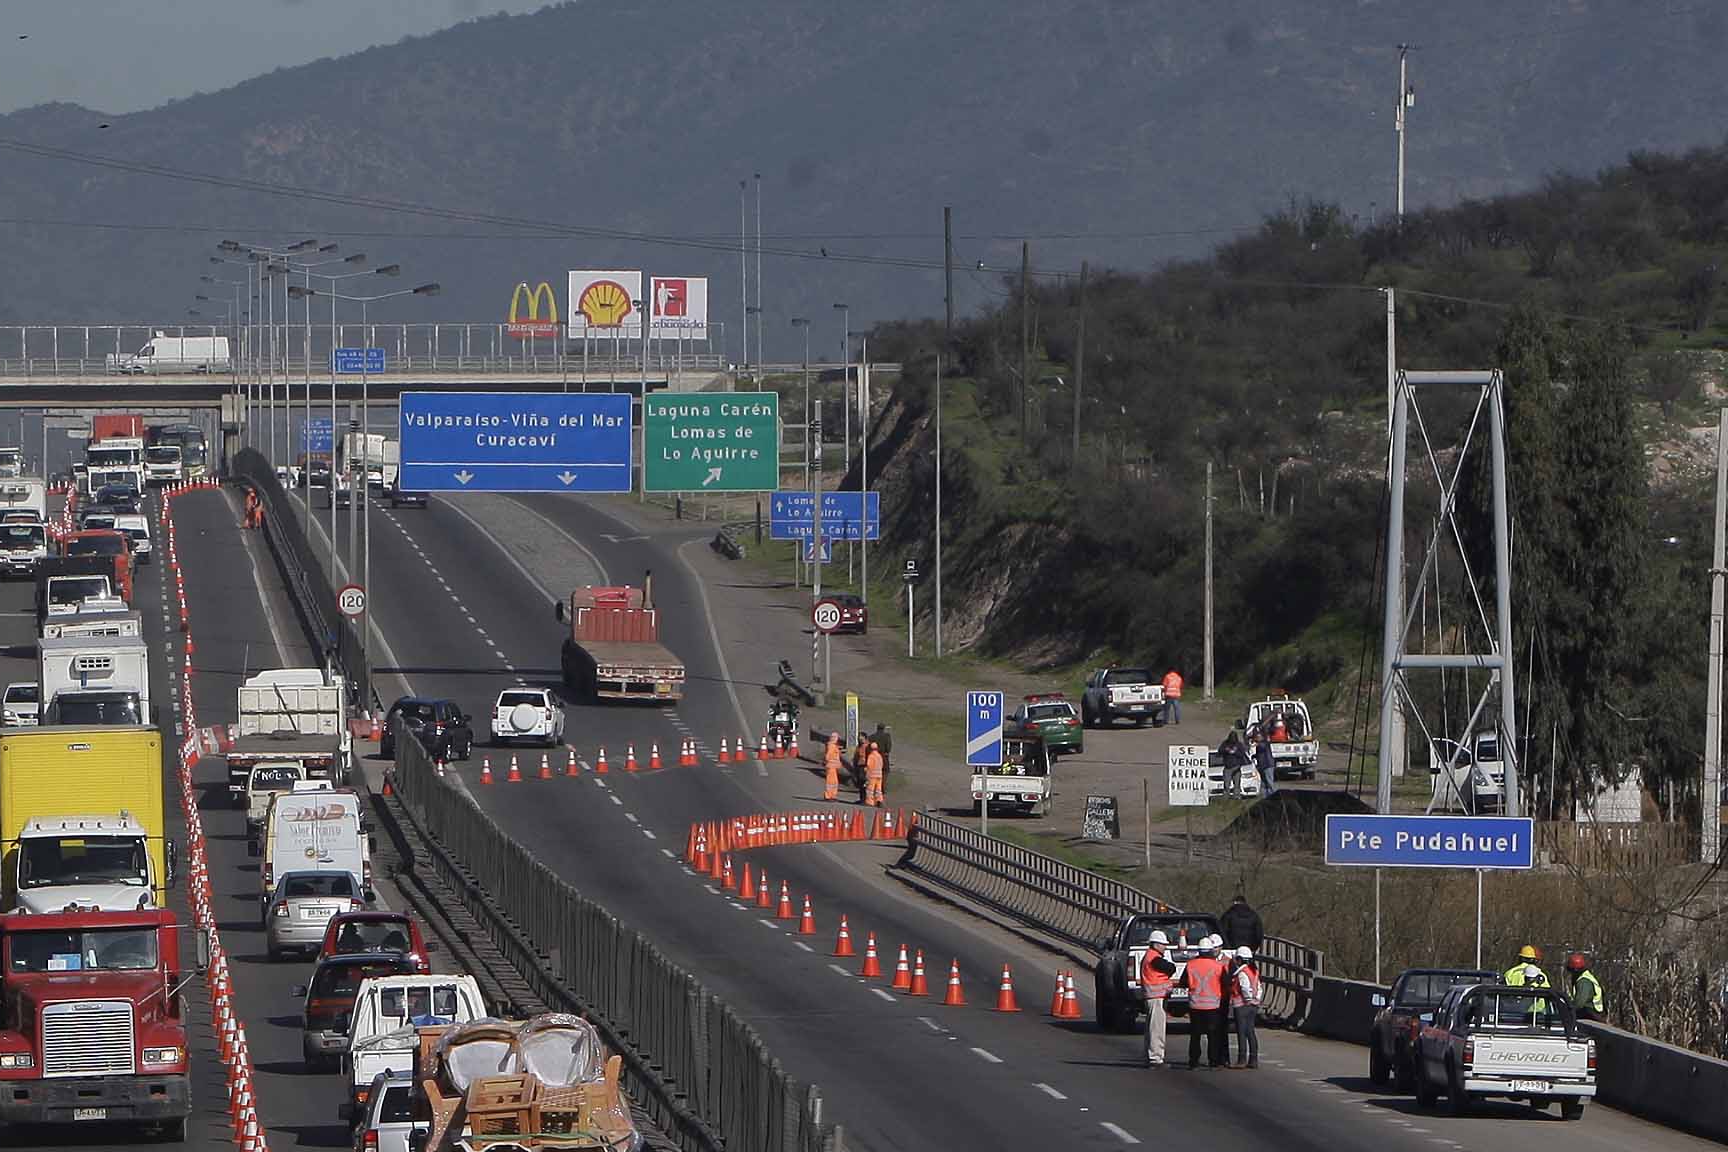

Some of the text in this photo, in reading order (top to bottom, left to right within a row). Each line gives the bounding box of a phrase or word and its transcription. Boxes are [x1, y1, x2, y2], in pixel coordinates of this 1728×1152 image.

[648, 402, 772, 421] Laguna Carén
[559, 414, 584, 427] del
[592, 414, 624, 427] Mar
[671, 425, 753, 438] Lomas de
[476, 433, 556, 447] Curacaví
[663, 447, 759, 463] Lo Aguirre
[824, 496, 835, 505] de
[788, 508, 800, 517] Lo
[341, 595, 364, 608] 120
[816, 609, 838, 623] 120
[972, 694, 997, 707] 100
[980, 710, 990, 719] m
[1178, 746, 1195, 755] SE
[1171, 758, 1207, 767] VENDE
[1171, 769, 1206, 779] ARENA
[1171, 781, 1205, 791] GRAVILLA
[1341, 831, 1518, 852] Pte Pudahuel
[1489, 1051, 1570, 1063] CHEVROLET
